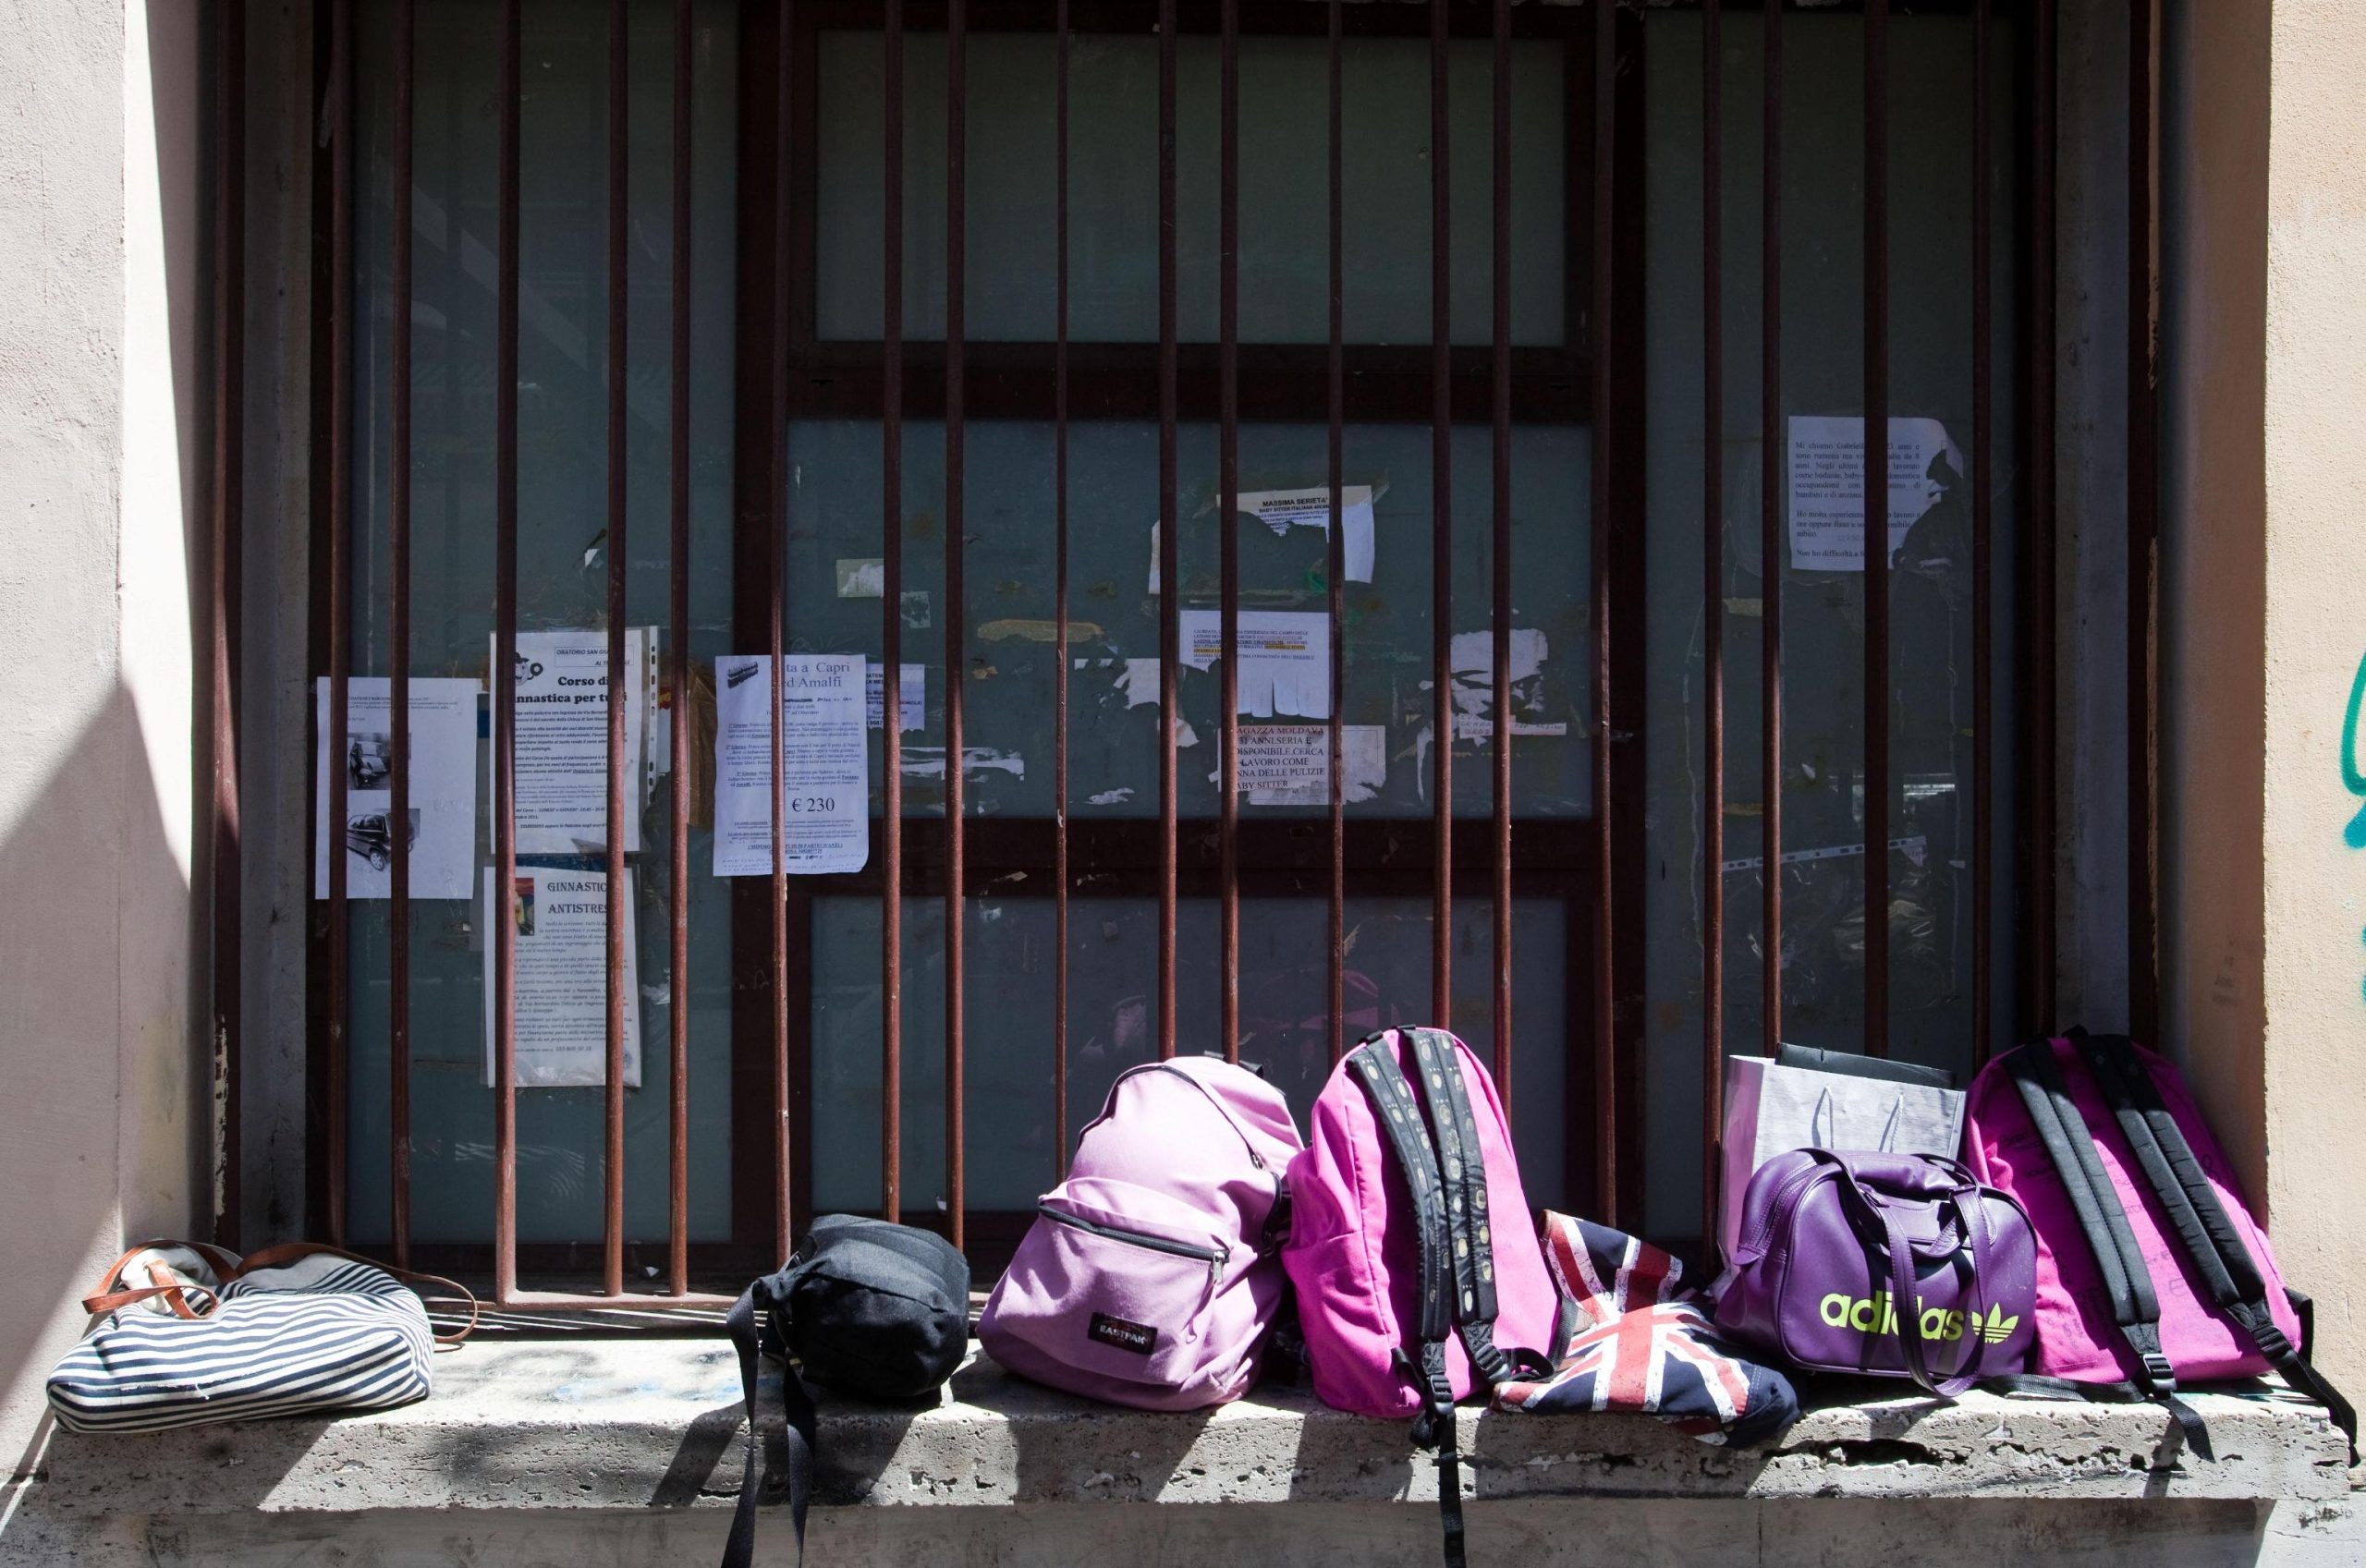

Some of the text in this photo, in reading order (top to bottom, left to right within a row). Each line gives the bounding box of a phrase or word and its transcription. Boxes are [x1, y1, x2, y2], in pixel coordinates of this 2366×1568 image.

[1262, 499, 1296, 507] MASSIMA
[801, 664, 809, 673] a
[816, 662, 850, 675] Capri
[557, 676, 595, 686] Corso
[798, 676, 842, 687] Amalfi
[516, 693, 571, 703] nnastica
[574, 695, 596, 705] per
[1276, 727, 1324, 735] MOLDAVA
[1306, 736, 1312, 745] E
[1292, 748, 1324, 756] CERCA
[1241, 758, 1310, 767] LAVORO COME
[1258, 769, 1287, 777] DELLE
[1289, 768, 1325, 776] PULIZIE
[1257, 780, 1288, 789] SITTER
[792, 797, 835, 812] € 230
[547, 881, 607, 892] GINNASTIC
[547, 903, 607, 914] ANTISTRES
[1820, 1290, 1964, 1341] adias
[1099, 1324, 1145, 1344] EASTPAK
